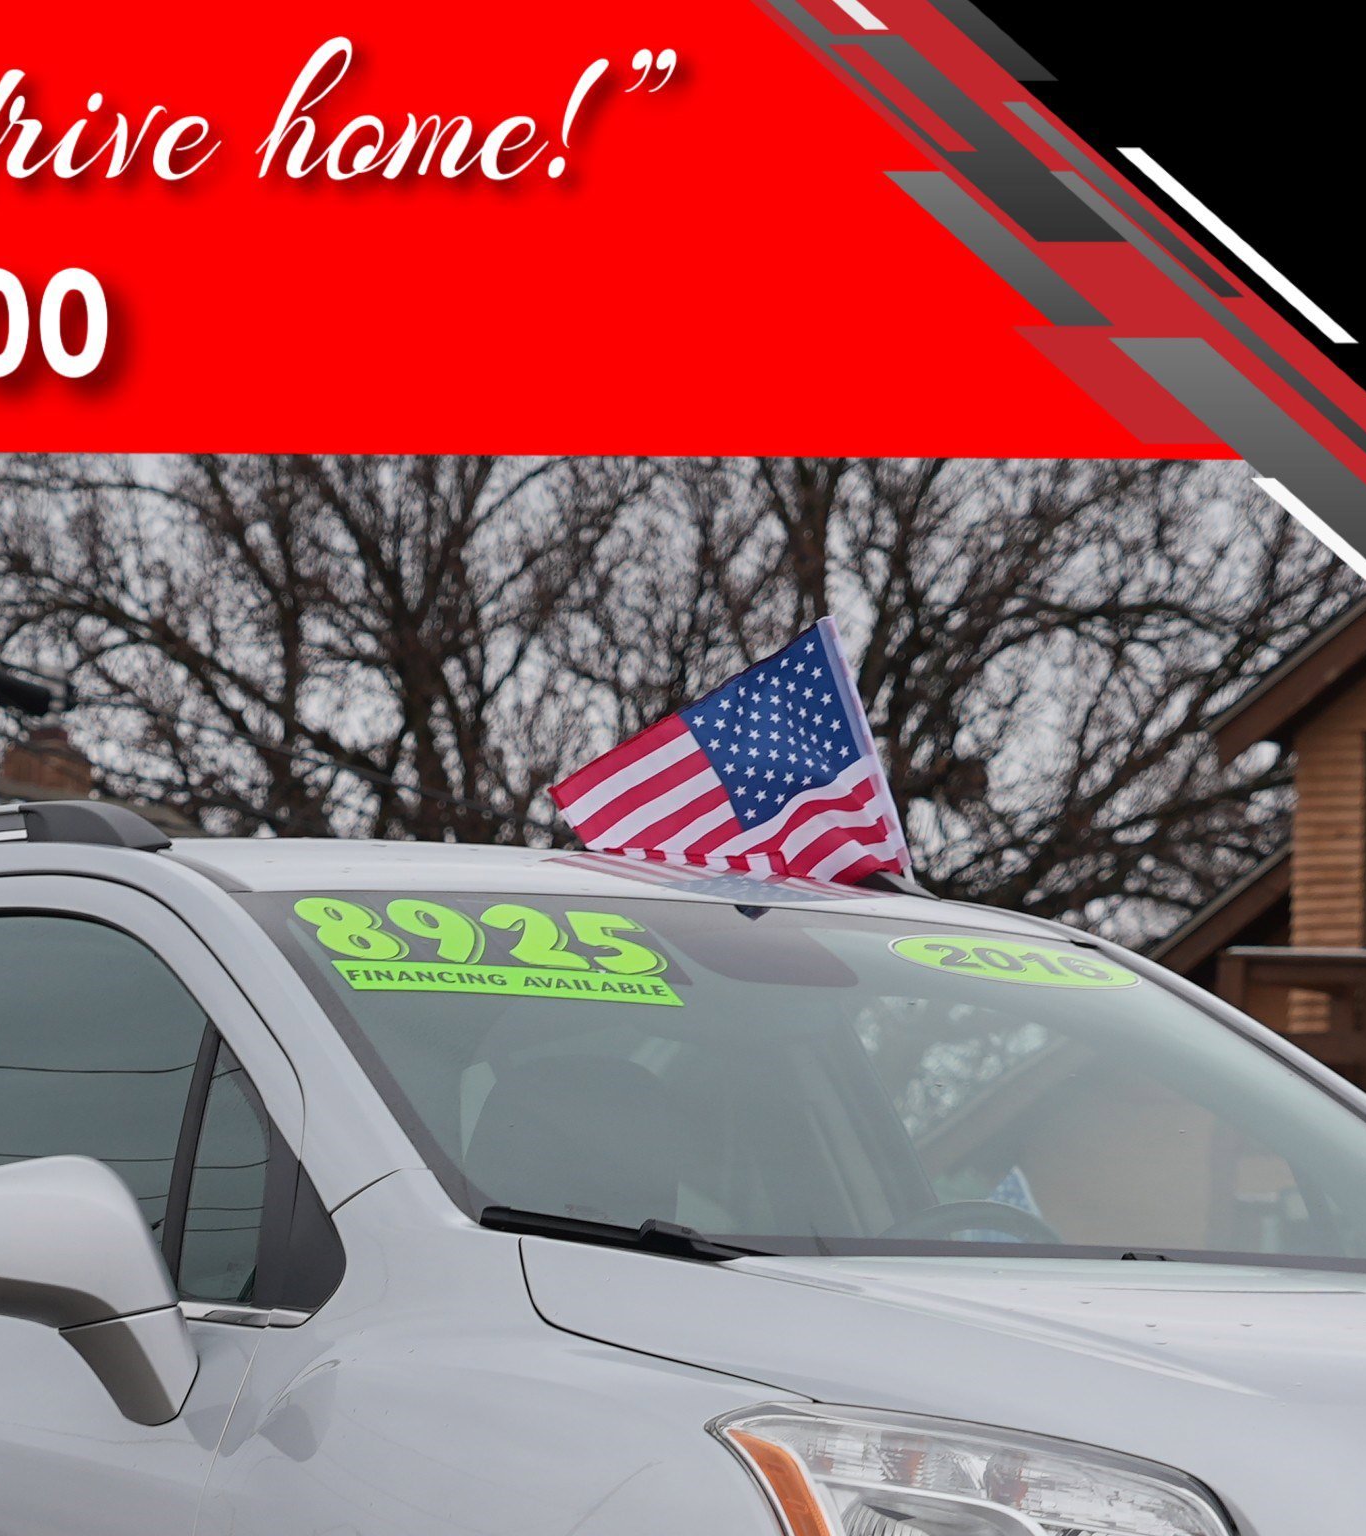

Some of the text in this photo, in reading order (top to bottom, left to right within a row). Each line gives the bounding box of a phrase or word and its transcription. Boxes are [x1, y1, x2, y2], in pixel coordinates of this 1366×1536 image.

[293, 896, 668, 976] 8925
[923, 943, 1113, 981] 2016
[347, 968, 669, 998] FINANCING AVAILABLE
